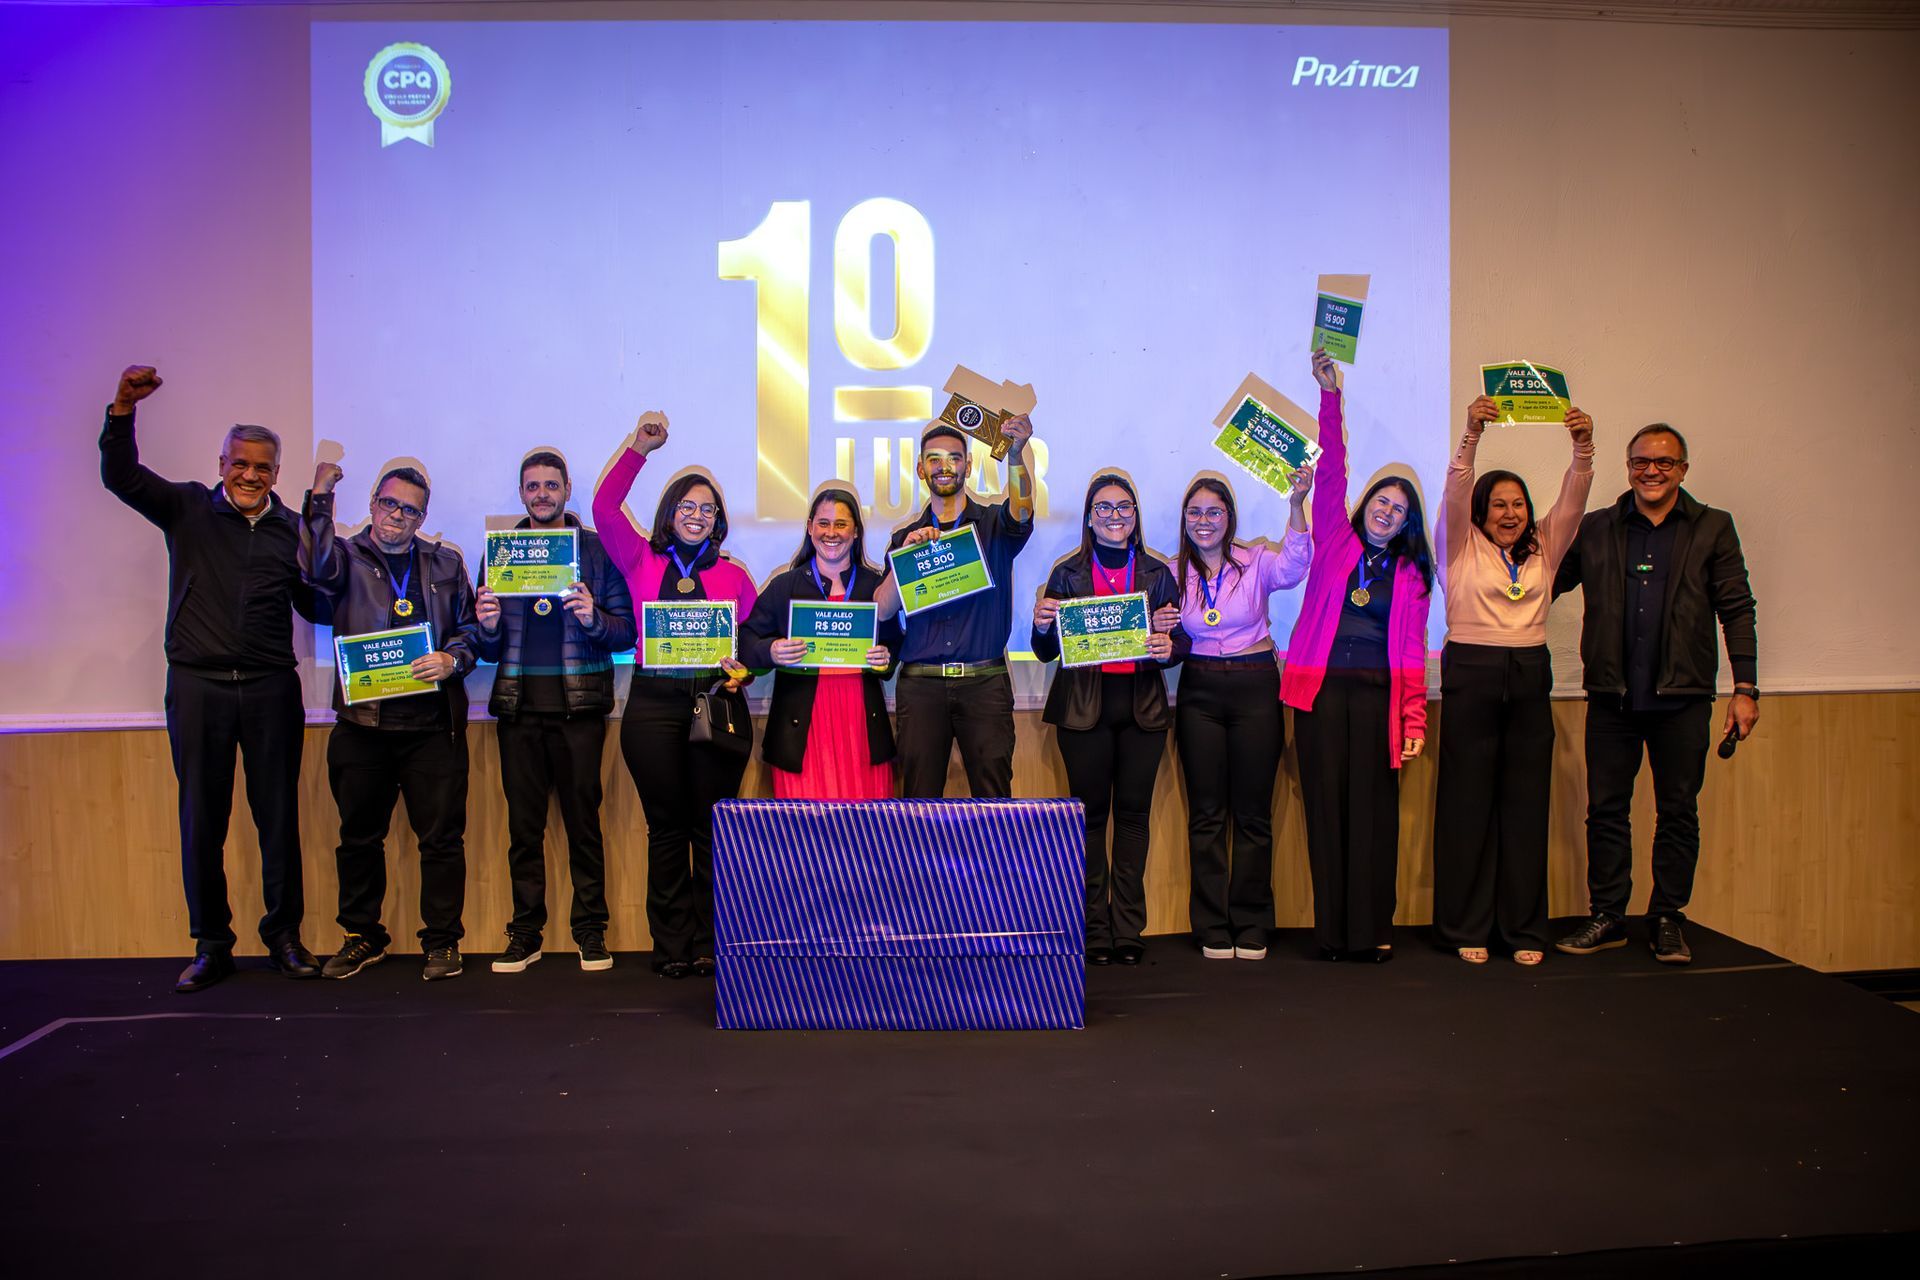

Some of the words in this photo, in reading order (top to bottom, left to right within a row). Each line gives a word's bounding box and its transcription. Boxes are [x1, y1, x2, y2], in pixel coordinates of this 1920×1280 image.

[1292, 56, 1420, 88] PRÁTICA
[383, 70, 432, 89] CPQ
[1332, 315, 1346, 326] 900
[1510, 380, 1524, 389] R$
[1261, 416, 1277, 430] VALE
[1275, 428, 1295, 444] ALELO
[1254, 425, 1269, 439] R$
[1268, 435, 1289, 452] 900
[835, 437, 1050, 519] LUAR
[511, 549, 525, 559] R$
[527, 549, 549, 558] 900
[913, 550, 930, 559] VALE
[931, 543, 952, 553] ALELO
[917, 559, 931, 571] R$
[933, 552, 955, 566] 900
[669, 622, 683, 631] R$
[686, 622, 707, 630] 900
[815, 621, 828, 631] R$
[831, 622, 852, 631] 900
[1084, 617, 1099, 627] R$
[1101, 615, 1122, 625] 900
[381, 639, 403, 647] ALELO
[365, 652, 380, 663] R$
[382, 649, 404, 661] 900
